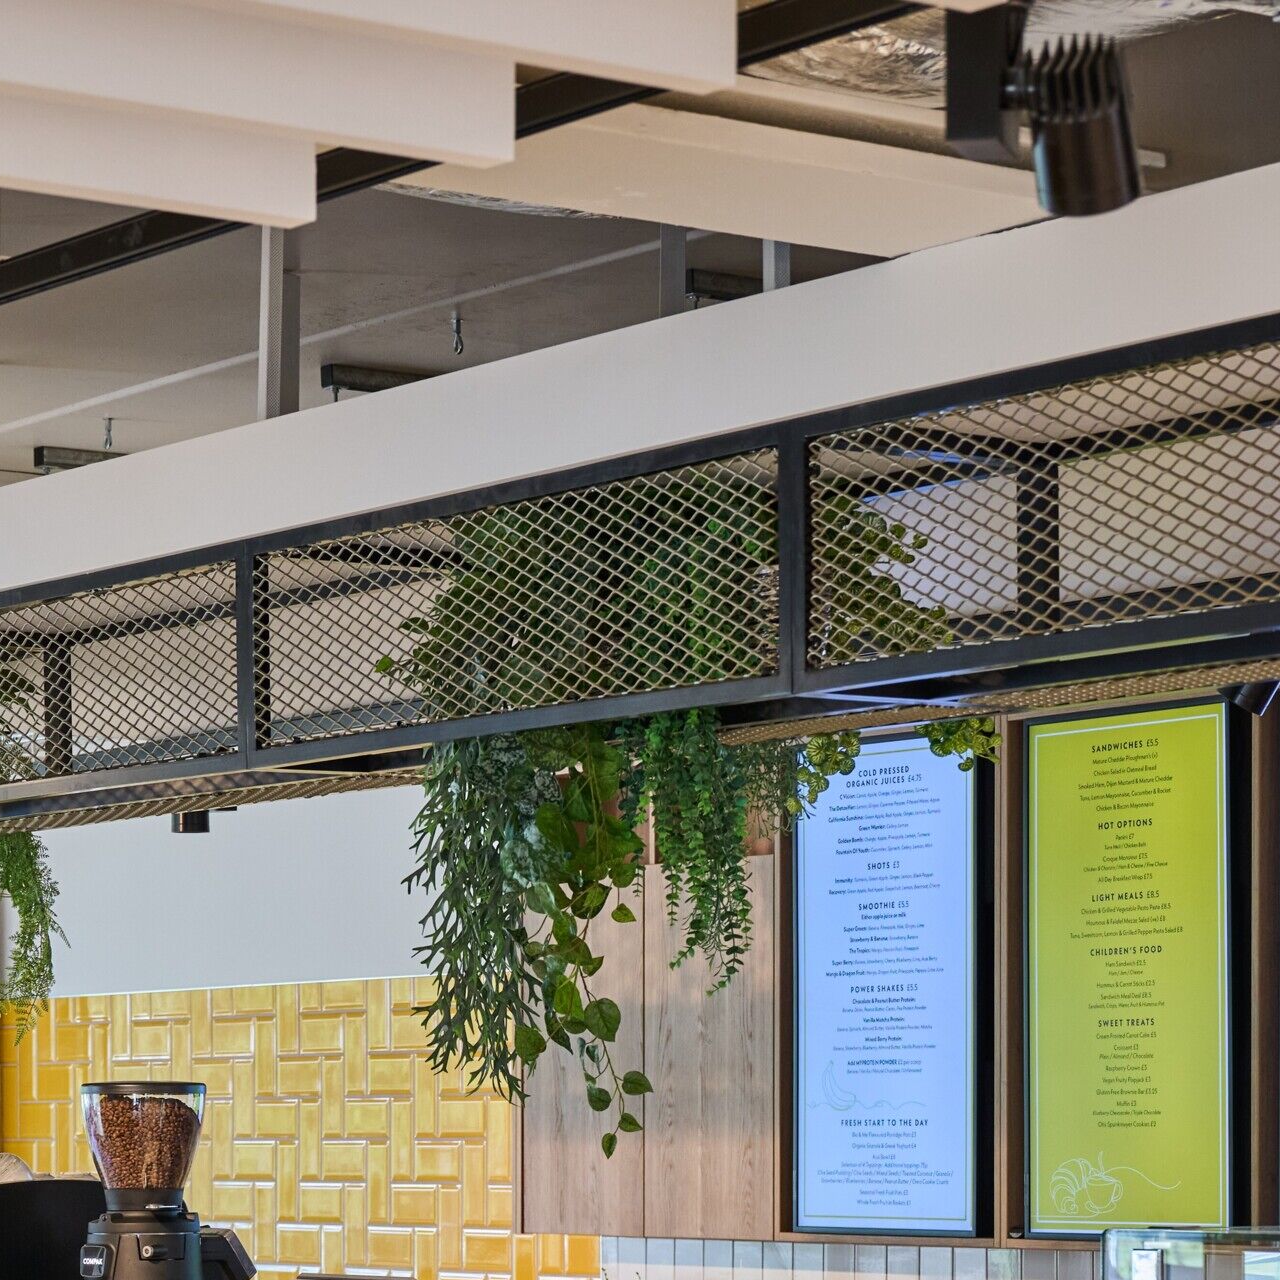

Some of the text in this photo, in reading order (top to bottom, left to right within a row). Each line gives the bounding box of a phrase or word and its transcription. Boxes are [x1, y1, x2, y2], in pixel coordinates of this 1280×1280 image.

[1092, 741, 1142, 753] SANDWICHES
[880, 766, 909, 775] PRESSED
[846, 774, 921, 788] ORGANIC JUICES £4.75
[1098, 818, 1152, 830] HOT OPTIONS
[868, 862, 890, 870] SHOTS
[1092, 890, 1159, 902] LIGHT MEALS £8.5
[859, 902, 895, 910] SMOOTHIE
[1090, 947, 1136, 956] CHILDREN'S
[1127, 1018, 1154, 1026] TREATS
[83, 1257, 103, 1266] COMPAK
